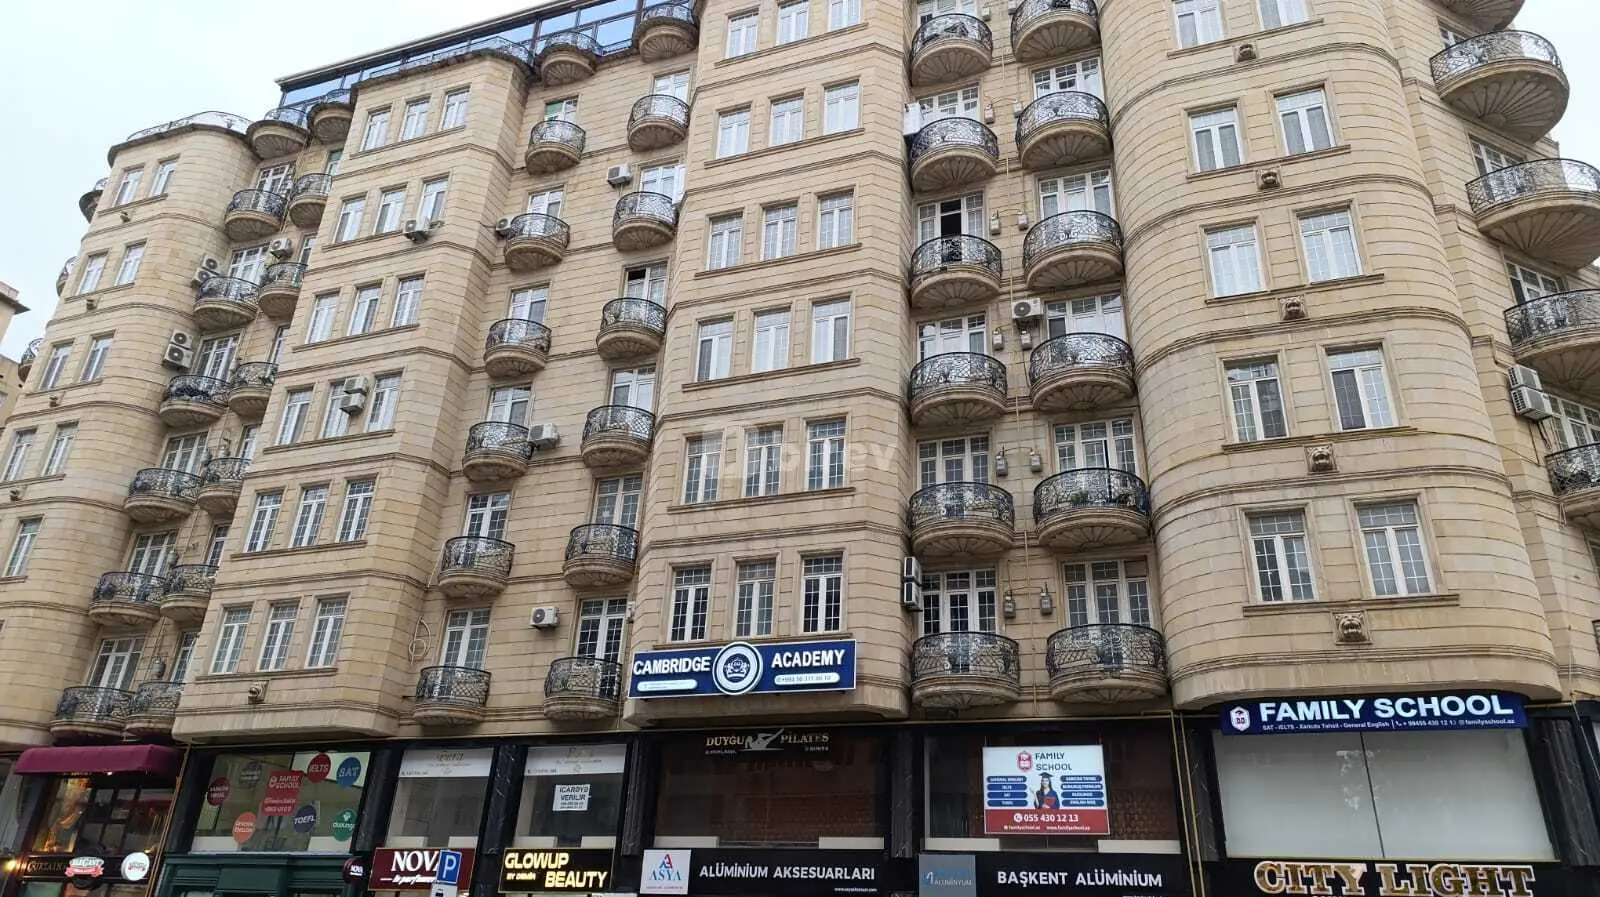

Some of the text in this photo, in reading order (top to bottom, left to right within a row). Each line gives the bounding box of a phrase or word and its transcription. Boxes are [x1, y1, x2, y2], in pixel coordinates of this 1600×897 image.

[633, 649, 845, 675] CAMBRIDGE ACADEMY
[1259, 695, 1514, 722] FAMILY SCHOOL
[1367, 721, 1390, 729] English
[1035, 752, 1065, 760] FAMILY
[309, 764, 329, 772] IELTS
[339, 767, 359, 777] SAT
[1035, 763, 1072, 771] SCHOOL
[294, 815, 315, 825] TOEFL
[1023, 814, 1079, 822] 055 430 12 13
[391, 851, 439, 872] NOV
[442, 855, 457, 879] P
[504, 852, 569, 869] GLOWUP
[545, 871, 608, 888] BEAUTY
[649, 869, 682, 881] ASYA
[773, 866, 875, 881] AKSESUARLARI
[997, 868, 1163, 888] BAŞKENT ALÜMİNİUM
[1254, 861, 1537, 897] CITY LIGHT
